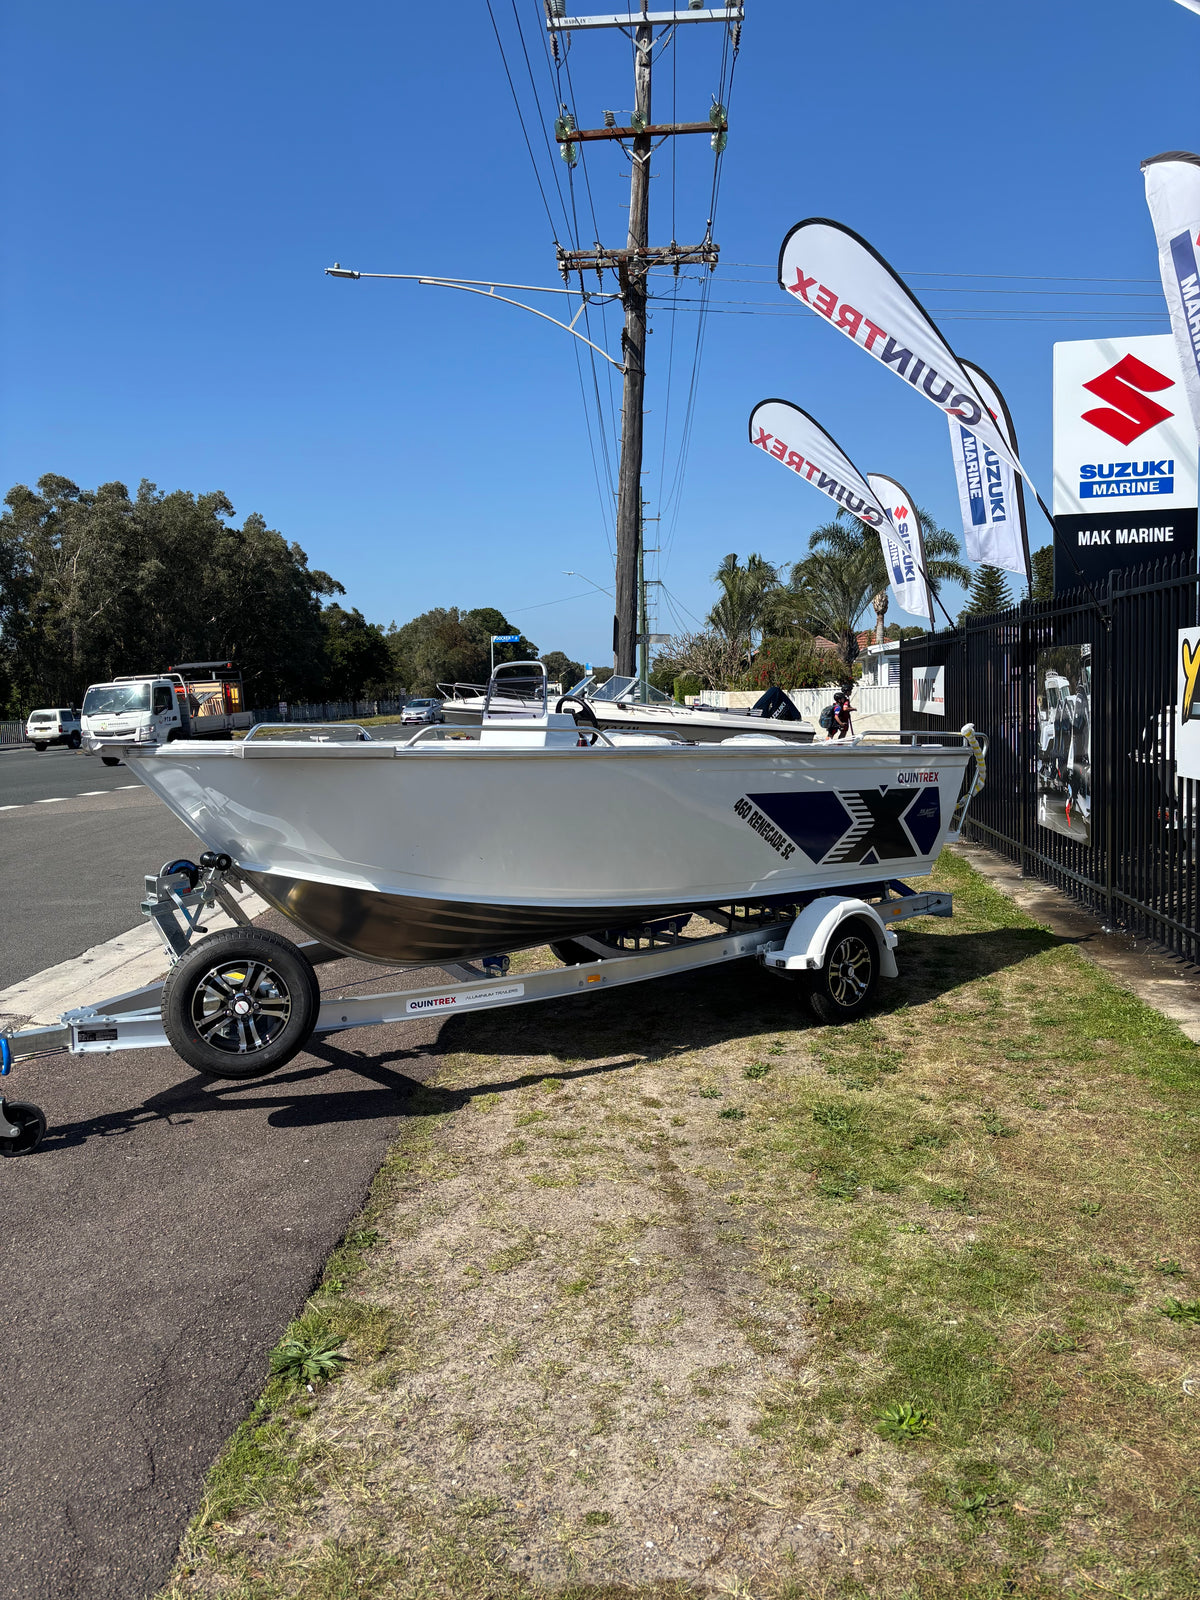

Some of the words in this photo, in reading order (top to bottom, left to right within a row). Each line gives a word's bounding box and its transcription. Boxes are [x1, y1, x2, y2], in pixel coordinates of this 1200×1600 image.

[963, 436, 982, 500] MARINE
[1079, 459, 1175, 480] SUZUKI
[983, 442, 1006, 522] UZUKI
[1092, 480, 1160, 496] MARINE
[1078, 530, 1112, 546] MAK
[1115, 526, 1175, 545] MARINE
[897, 772, 940, 784] QUINTREX
[733, 797, 753, 820] 460
[747, 810, 788, 853] RENEGADE
[780, 842, 796, 861] SC
[410, 996, 457, 1009] QUINTREX
